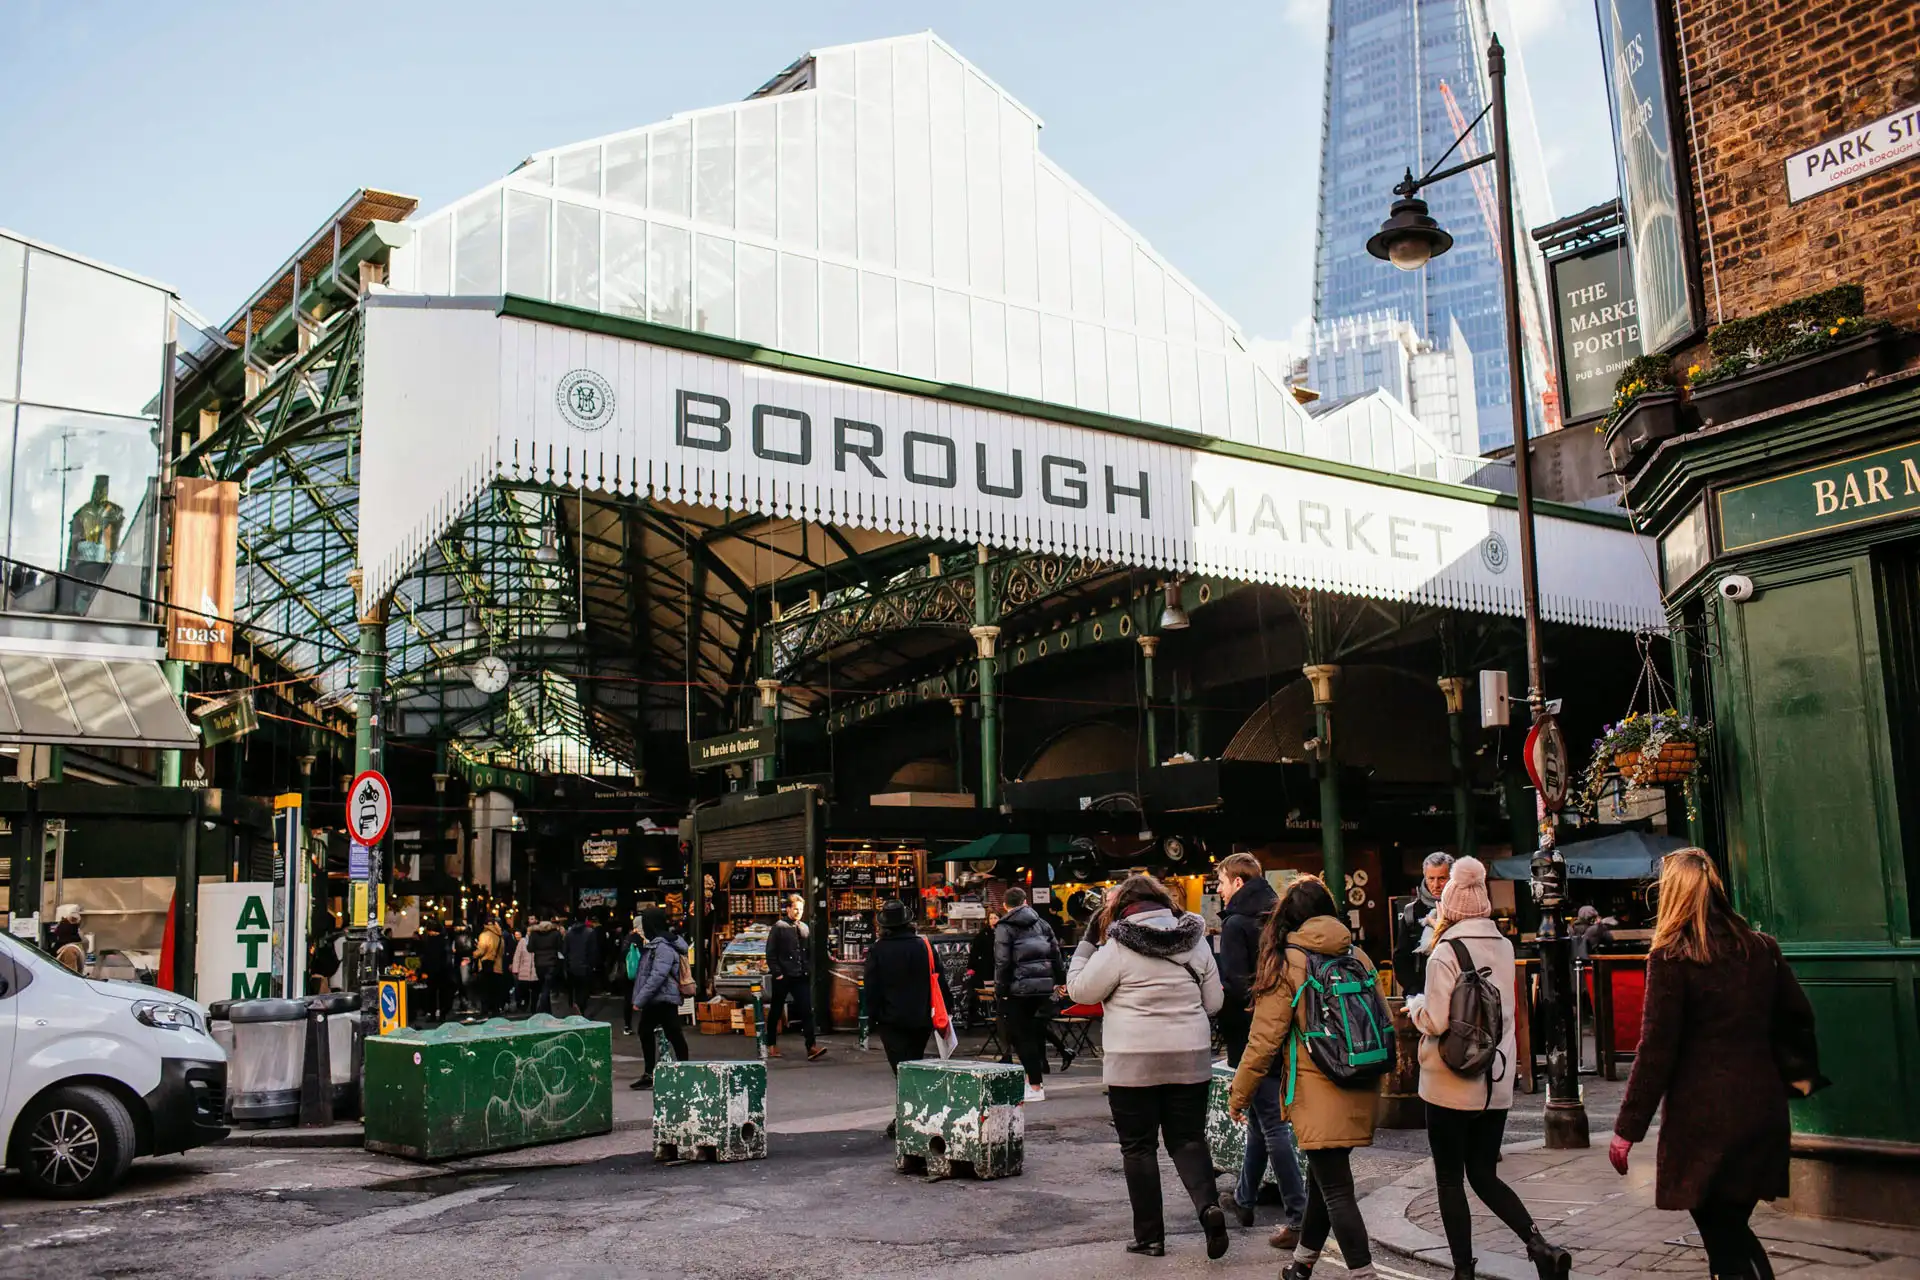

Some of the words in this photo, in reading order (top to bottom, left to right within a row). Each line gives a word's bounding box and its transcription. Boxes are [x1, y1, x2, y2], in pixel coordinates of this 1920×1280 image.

[1806, 131, 1874, 177] PARK
[1829, 161, 1866, 181] LONDON
[1869, 143, 1913, 166] BOROUGH
[1567, 282, 1608, 308] THE
[1572, 324, 1640, 358] PORTE
[1575, 370, 1593, 381] PUB
[1595, 367, 1604, 376] &
[675, 388, 1150, 520] BOROUGH
[1191, 480, 1453, 565] MARKET
[1812, 466, 1894, 516] BAR
[177, 626, 226, 643] roast
[702, 747, 710, 758] Le
[710, 743, 729, 757] Marché
[737, 738, 760, 753] Quartier
[182, 778, 209, 787] roast
[231, 895, 271, 1000] ATM
